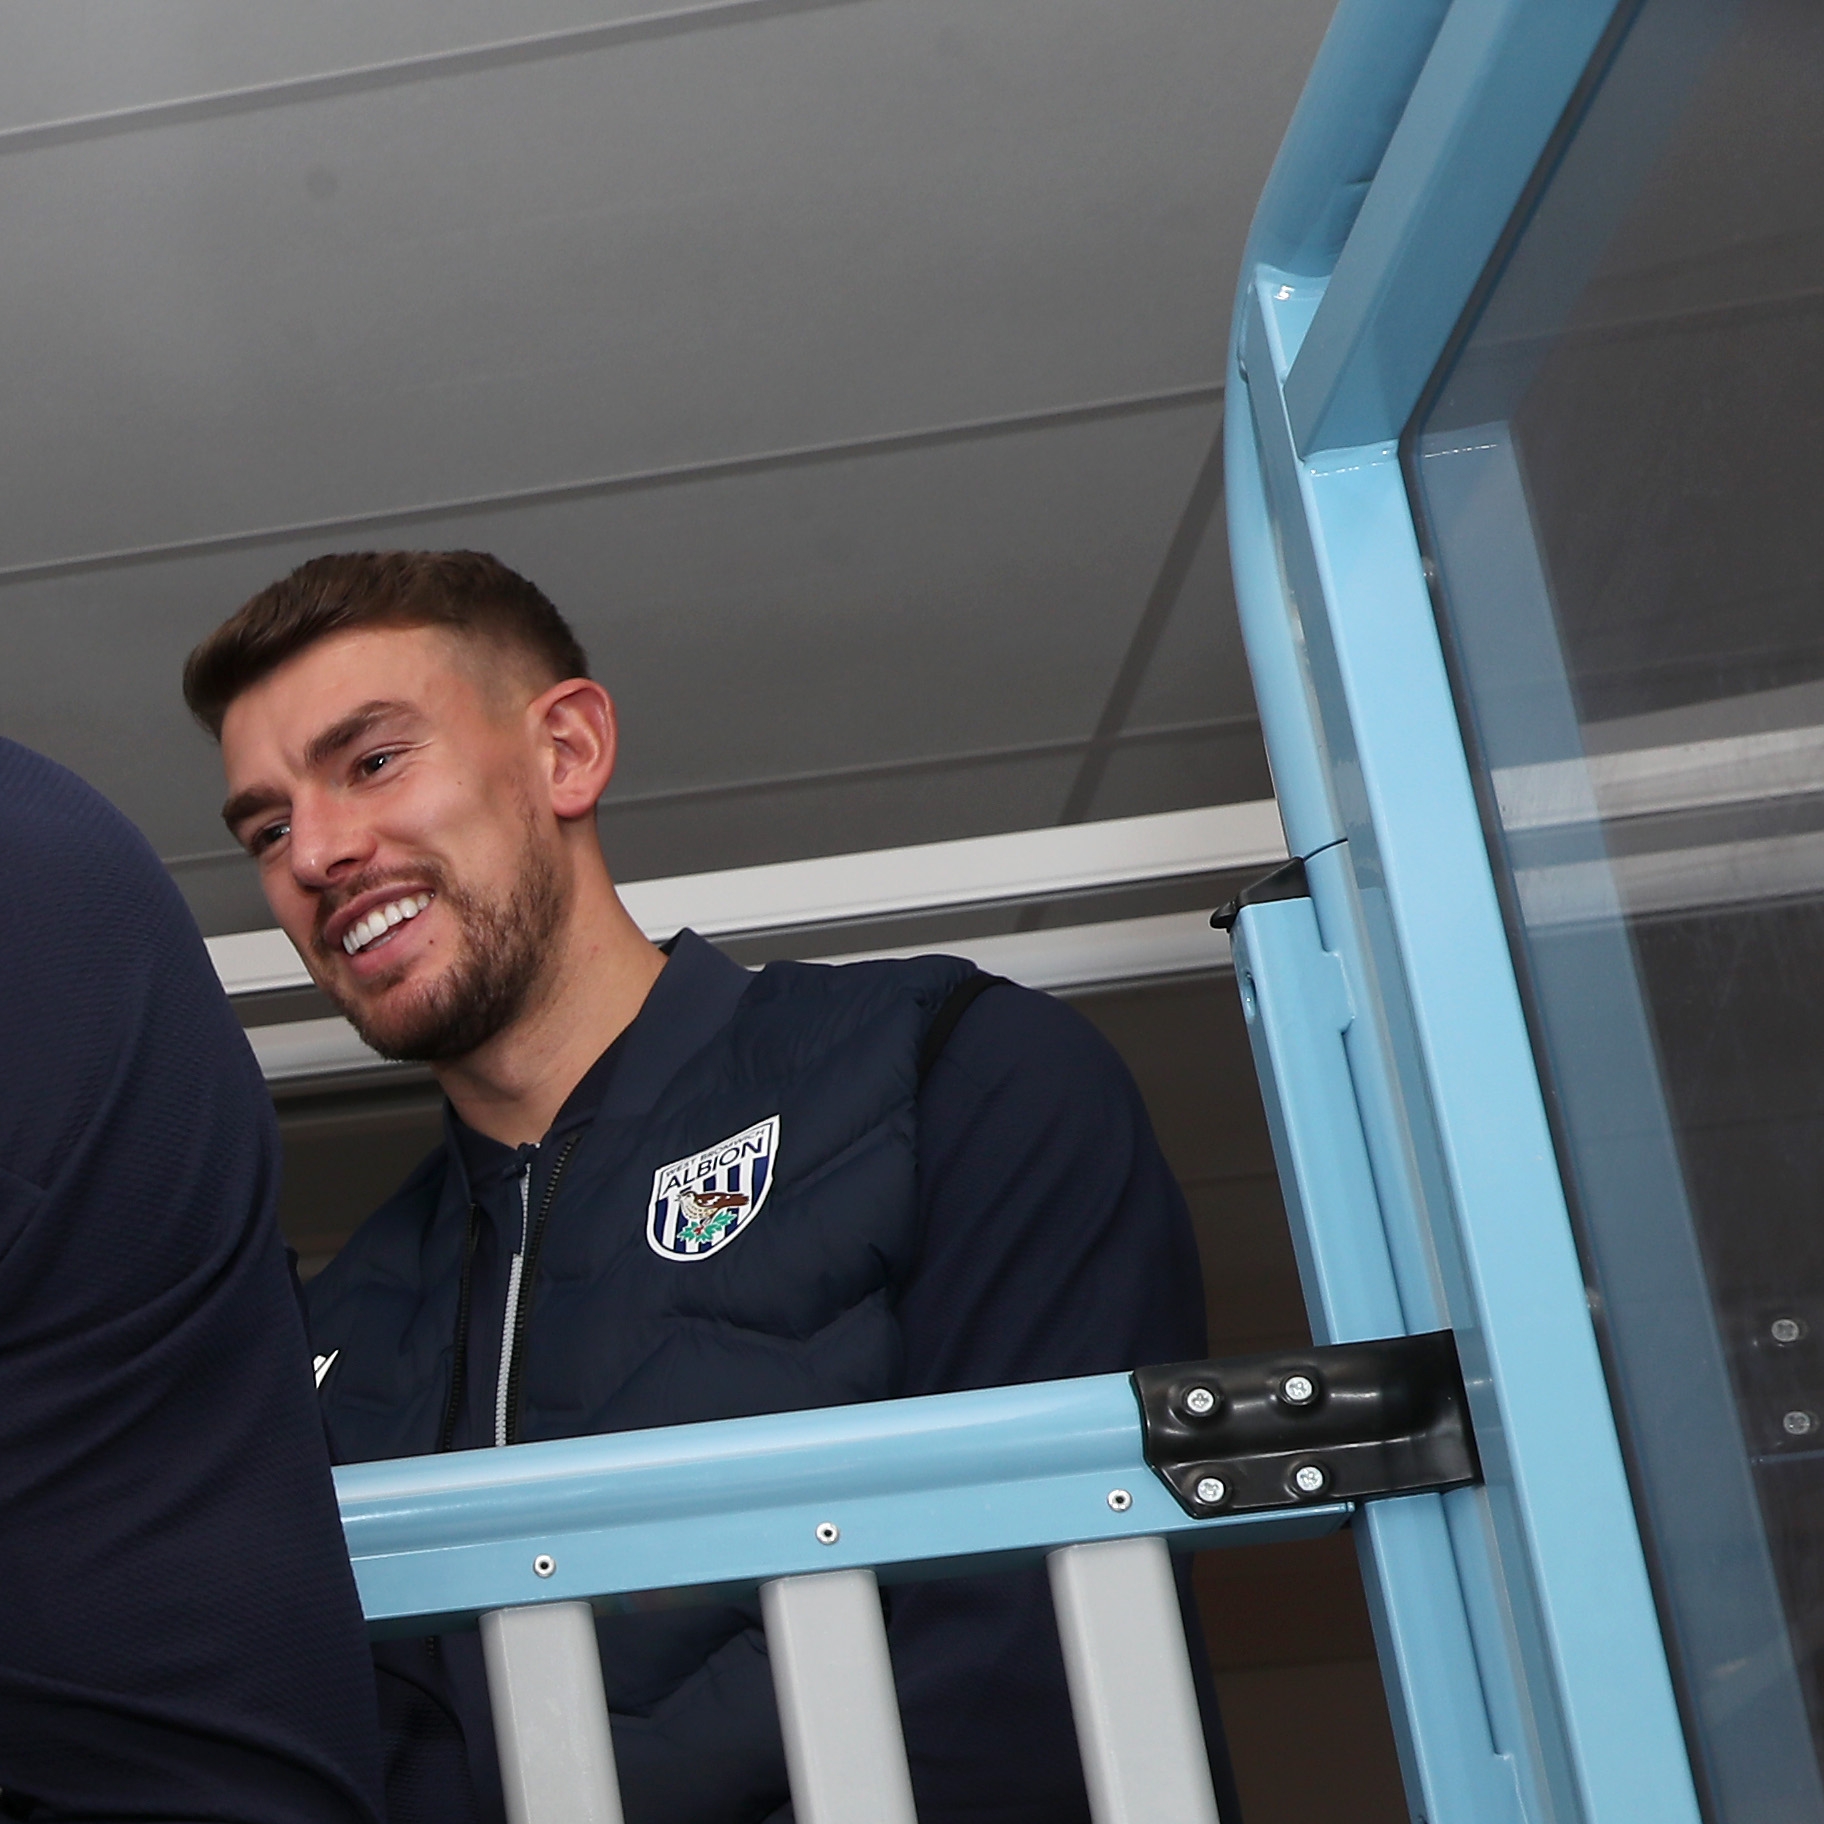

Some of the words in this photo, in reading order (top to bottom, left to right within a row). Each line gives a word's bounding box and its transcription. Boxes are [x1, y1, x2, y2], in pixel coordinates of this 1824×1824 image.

[662, 1137, 763, 1195] ALBION
[666, 1158, 696, 1177] WEST
[700, 1129, 765, 1160] BROMWICH
